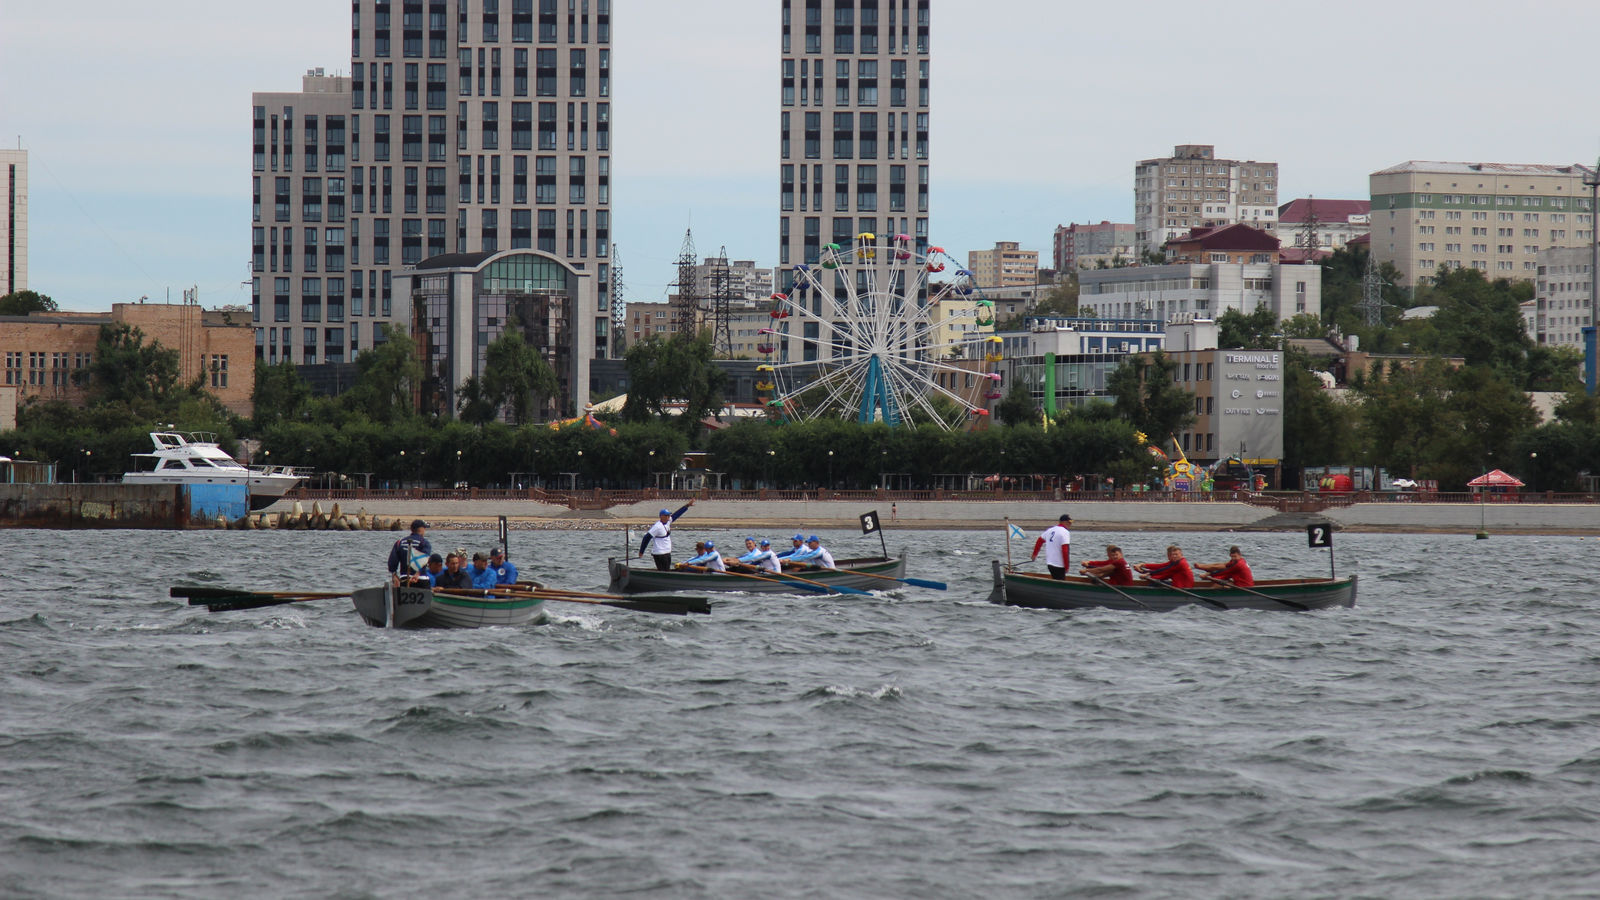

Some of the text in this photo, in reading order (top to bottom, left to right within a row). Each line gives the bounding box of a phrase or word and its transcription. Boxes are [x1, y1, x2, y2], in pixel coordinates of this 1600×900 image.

[1226, 354, 1279, 363] TERMINAL E
[500, 519, 504, 540] 1
[864, 515, 874, 530] 3
[1049, 531, 1056, 542] 2
[1314, 527, 1324, 544] 2
[401, 592, 425, 605] 292
